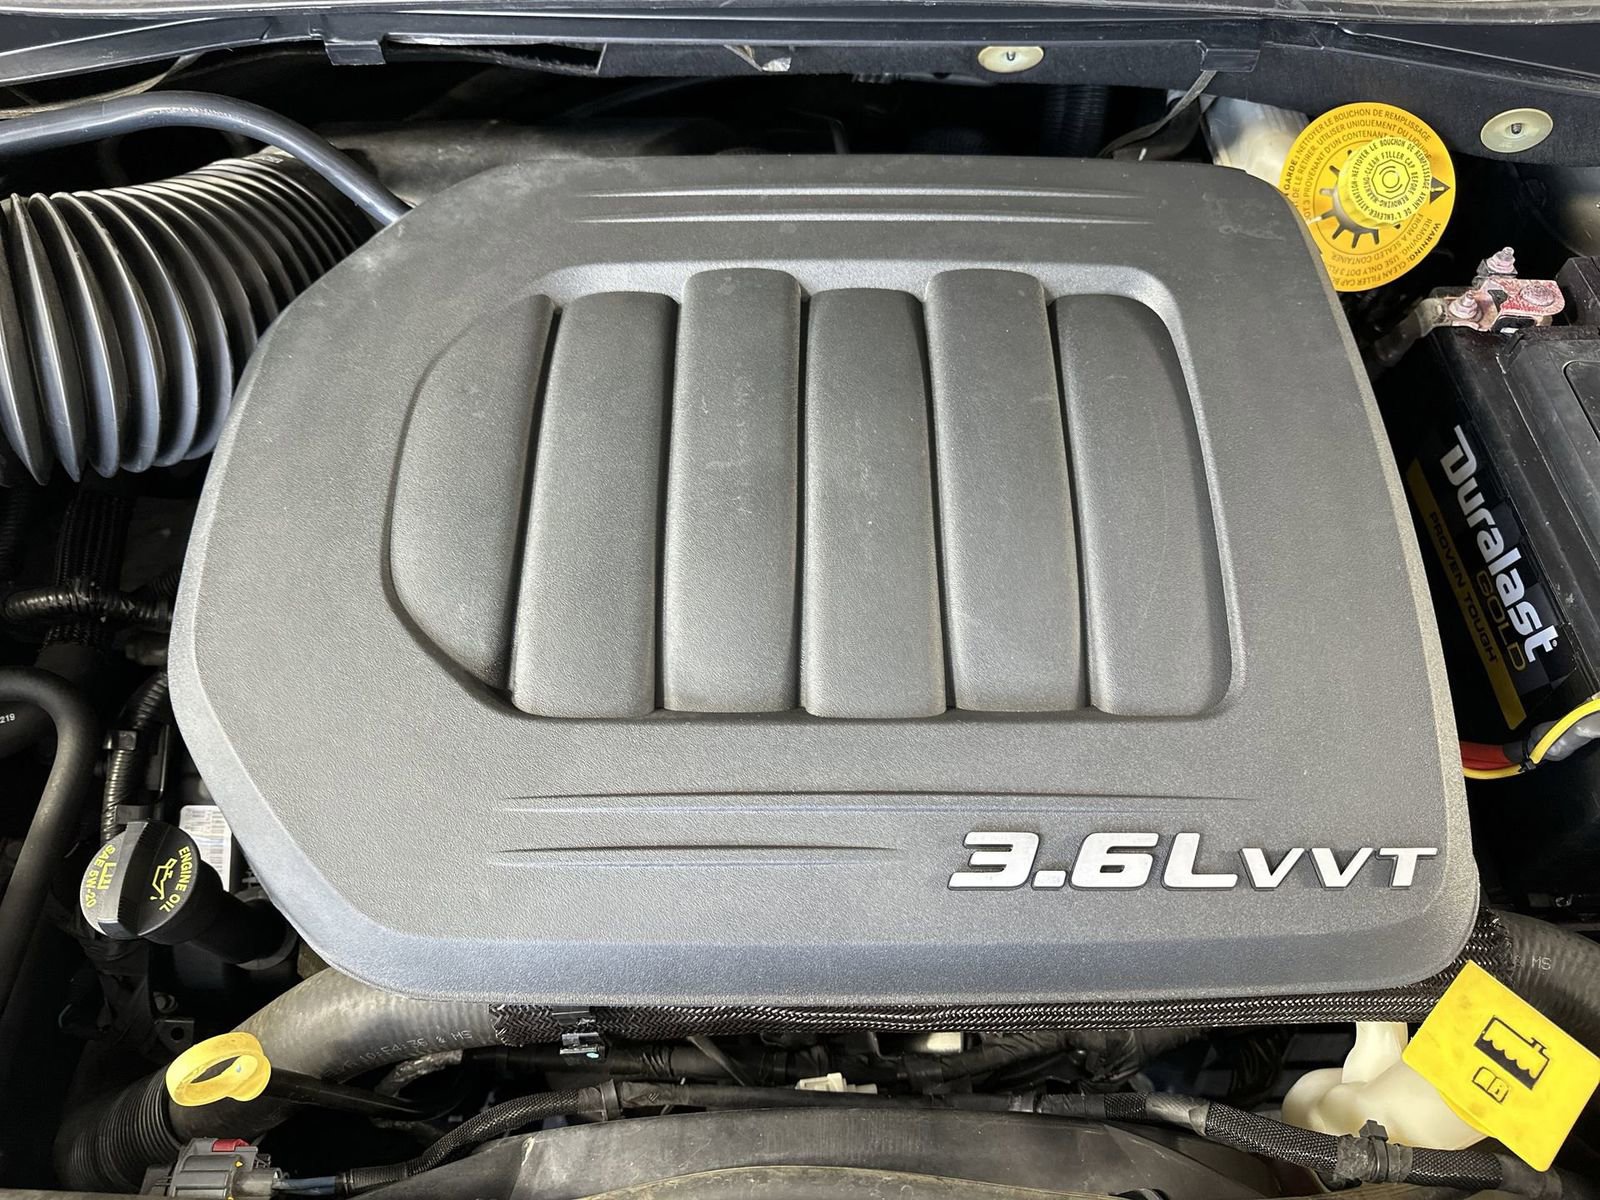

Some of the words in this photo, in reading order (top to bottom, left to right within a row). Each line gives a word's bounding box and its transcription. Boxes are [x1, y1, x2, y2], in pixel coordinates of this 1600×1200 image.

[1296, 124, 1324, 154] NETTOYER
[1323, 118, 1334, 127] LE
[1333, 109, 1371, 122] BOUCHON
[1373, 109, 1383, 117] DE
[1384, 110, 1431, 141] REMPLISSAGE
[1317, 124, 1345, 145] UTILISER
[1346, 119, 1397, 131] UNIQUEMENT
[1397, 127, 1409, 137] DU
[1369, 143, 1378, 152] LE
[1379, 139, 1405, 148] BOUCHON
[1406, 143, 1414, 152] DE
[1381, 151, 1405, 160] FILLER
[1407, 212, 1423, 236] FROM
[1374, 240, 1402, 260] SEALED
[1386, 255, 1400, 265] USE
[1357, 273, 1382, 285] FILLER
[1363, 263, 1383, 274] ONLY
[1382, 261, 1407, 278] CLEAN
[1440, 424, 1559, 663] Duralast
[1429, 511, 1466, 587] PROVEN
[1464, 592, 1497, 662] TOUGH
[1476, 570, 1527, 672] GOLD
[94, 844, 116, 868] SAE
[1240, 847, 1438, 889] VVT
[175, 846, 193, 892] ENGINE
[85, 869, 100, 908] 5W-20
[159, 893, 181, 913] OIL
